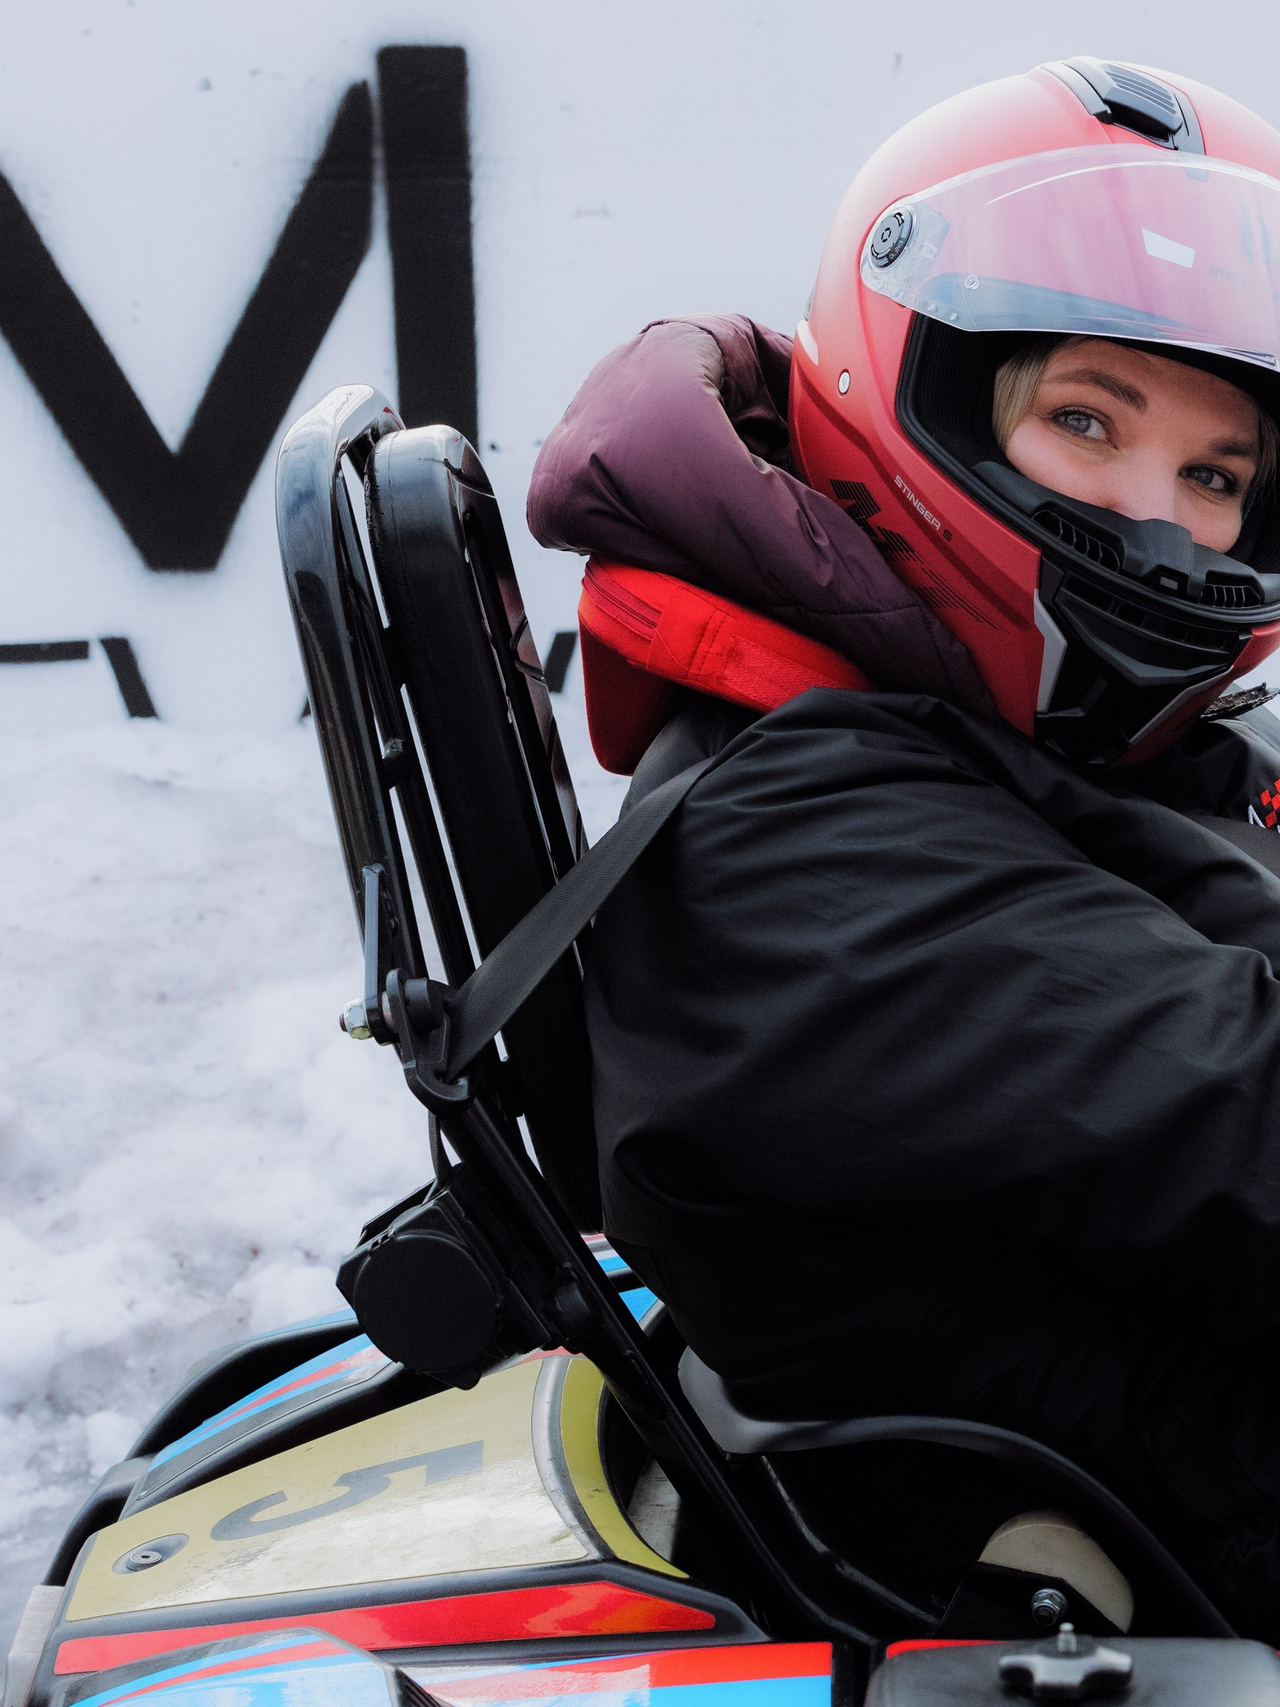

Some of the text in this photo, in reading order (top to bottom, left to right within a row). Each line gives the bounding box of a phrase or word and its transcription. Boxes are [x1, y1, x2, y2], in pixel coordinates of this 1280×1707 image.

[894, 474, 953, 542] STINGER S
[210, 1440, 484, 1541] 5
